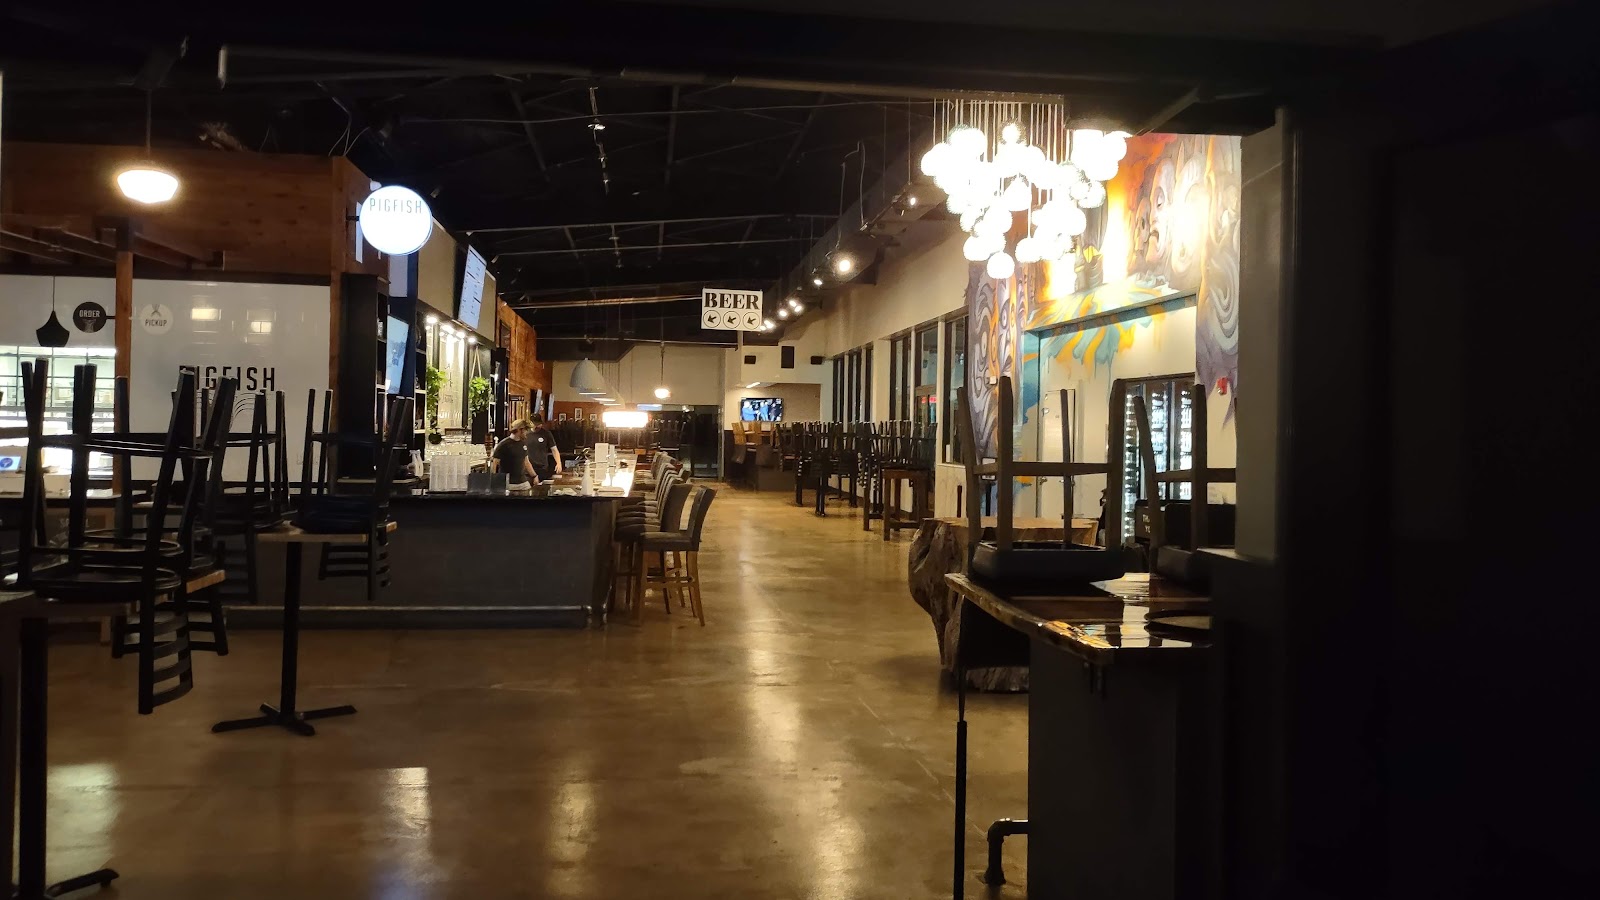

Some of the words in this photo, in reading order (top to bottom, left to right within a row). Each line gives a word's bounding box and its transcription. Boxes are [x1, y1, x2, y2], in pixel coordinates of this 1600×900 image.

[370, 197, 422, 214] PIGFISH
[704, 292, 760, 310] BEER
[79, 309, 101, 318] ORDER
[145, 319, 167, 327] PICKUP
[180, 366, 275, 391] IGISH
